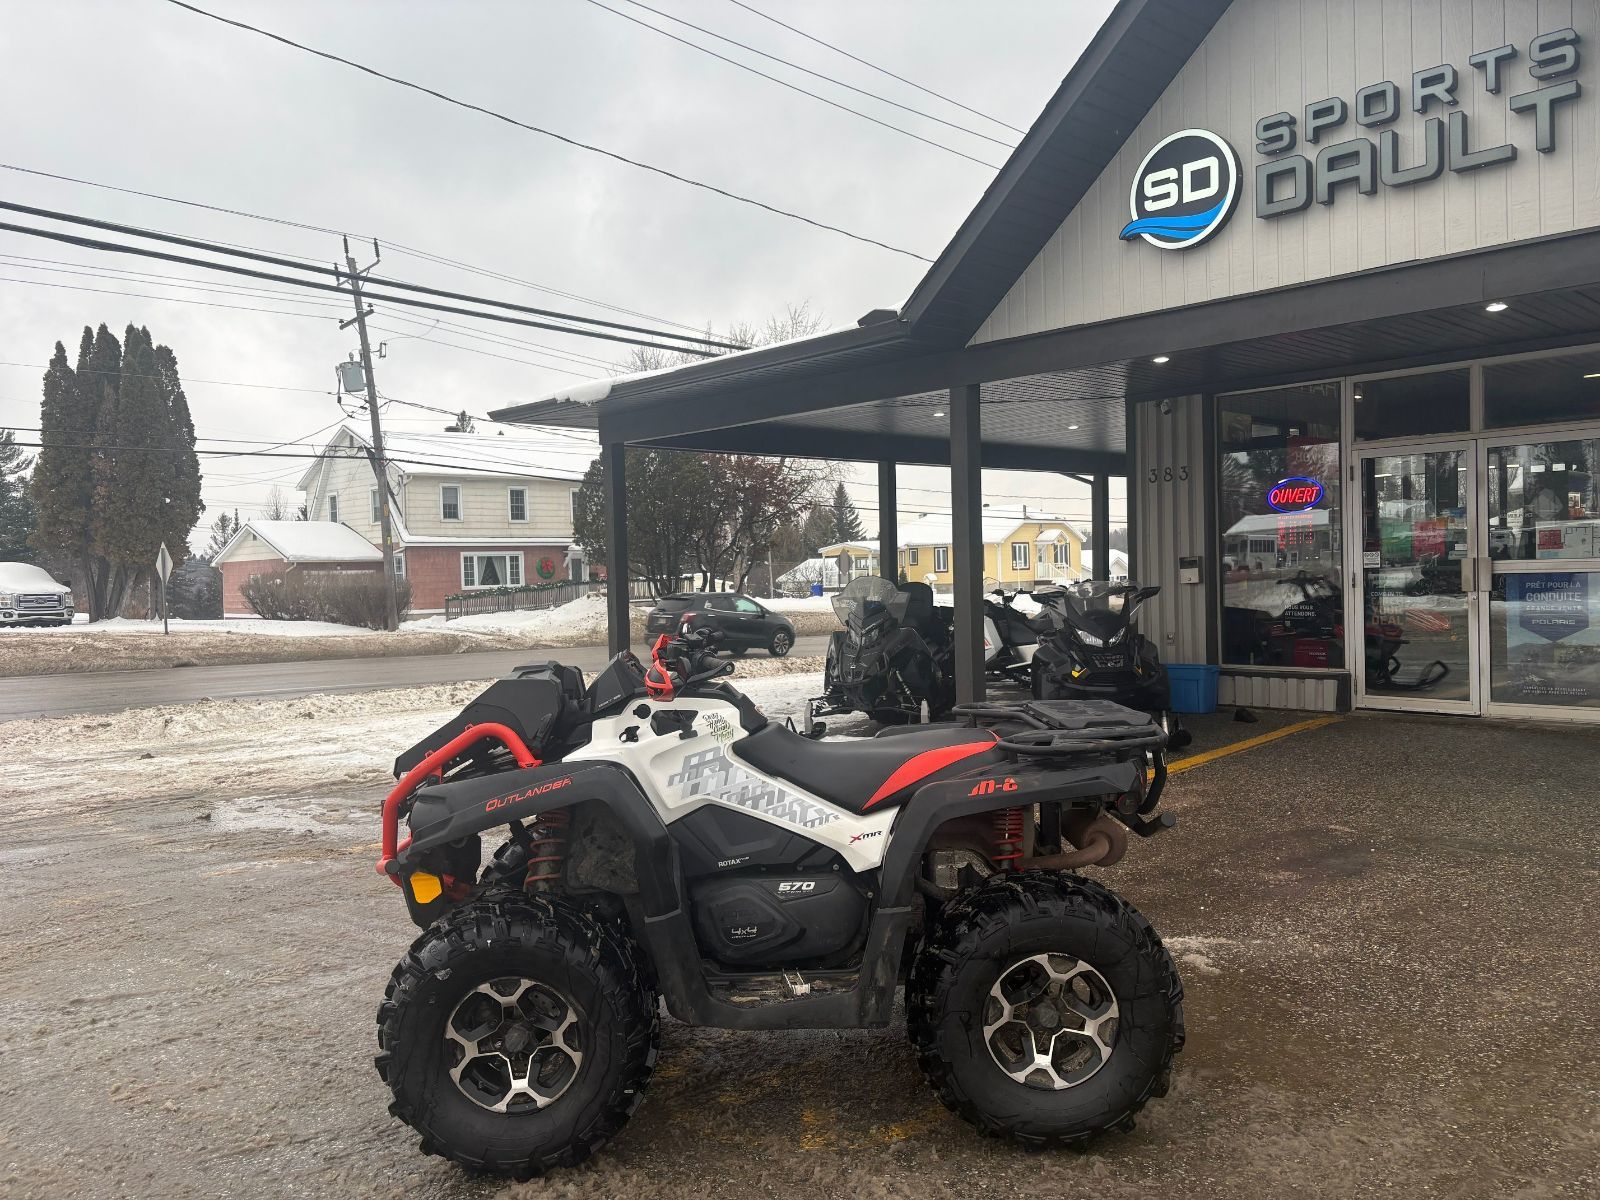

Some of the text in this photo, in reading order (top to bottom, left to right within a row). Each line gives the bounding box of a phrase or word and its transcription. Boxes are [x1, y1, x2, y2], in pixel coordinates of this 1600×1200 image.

[1256, 28, 1580, 154] SPORTS
[1256, 80, 1581, 219] DAULT
[1143, 155, 1220, 212] SD
[1149, 466, 1189, 484] 383
[1270, 486, 1320, 504] OUVERT
[1547, 581, 1568, 589] POUR
[1525, 592, 1582, 602] CONDUITE
[485, 775, 573, 811] OUTLANDER
[718, 858, 741, 868] ROTAX
[778, 881, 816, 891] 570
